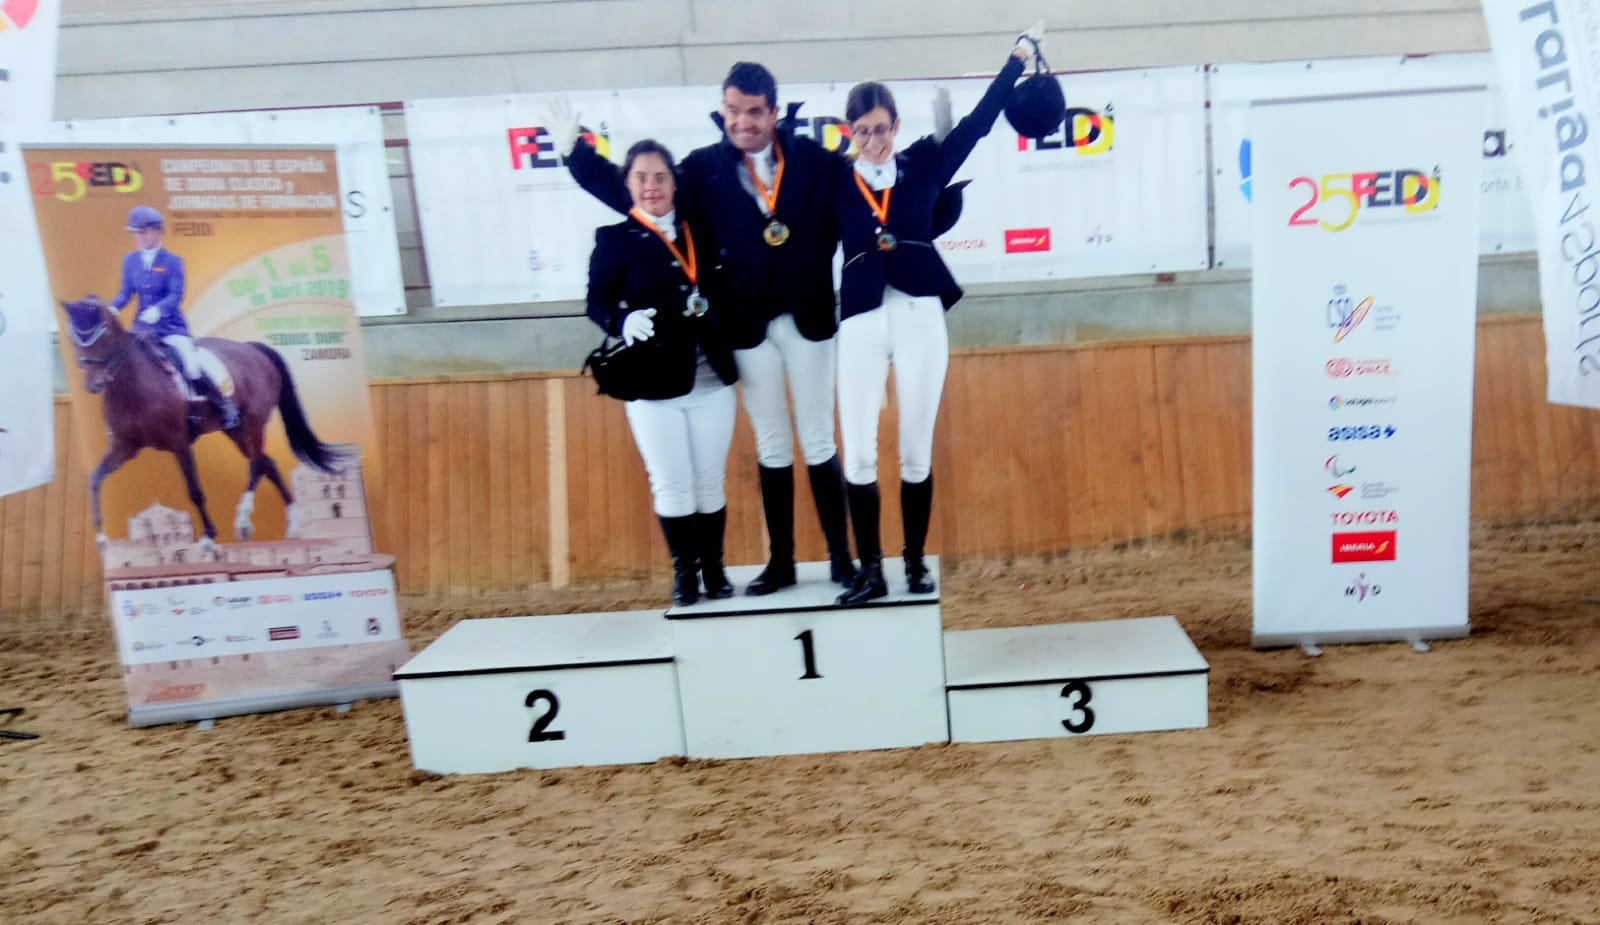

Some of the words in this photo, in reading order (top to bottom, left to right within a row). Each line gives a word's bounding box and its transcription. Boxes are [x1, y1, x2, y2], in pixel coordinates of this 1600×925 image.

[312, 245, 331, 273] 5
[1331, 510, 1399, 526] TOYOTA
[793, 628, 822, 680] 1
[524, 689, 566, 743] 2
[1059, 679, 1096, 735] 3
